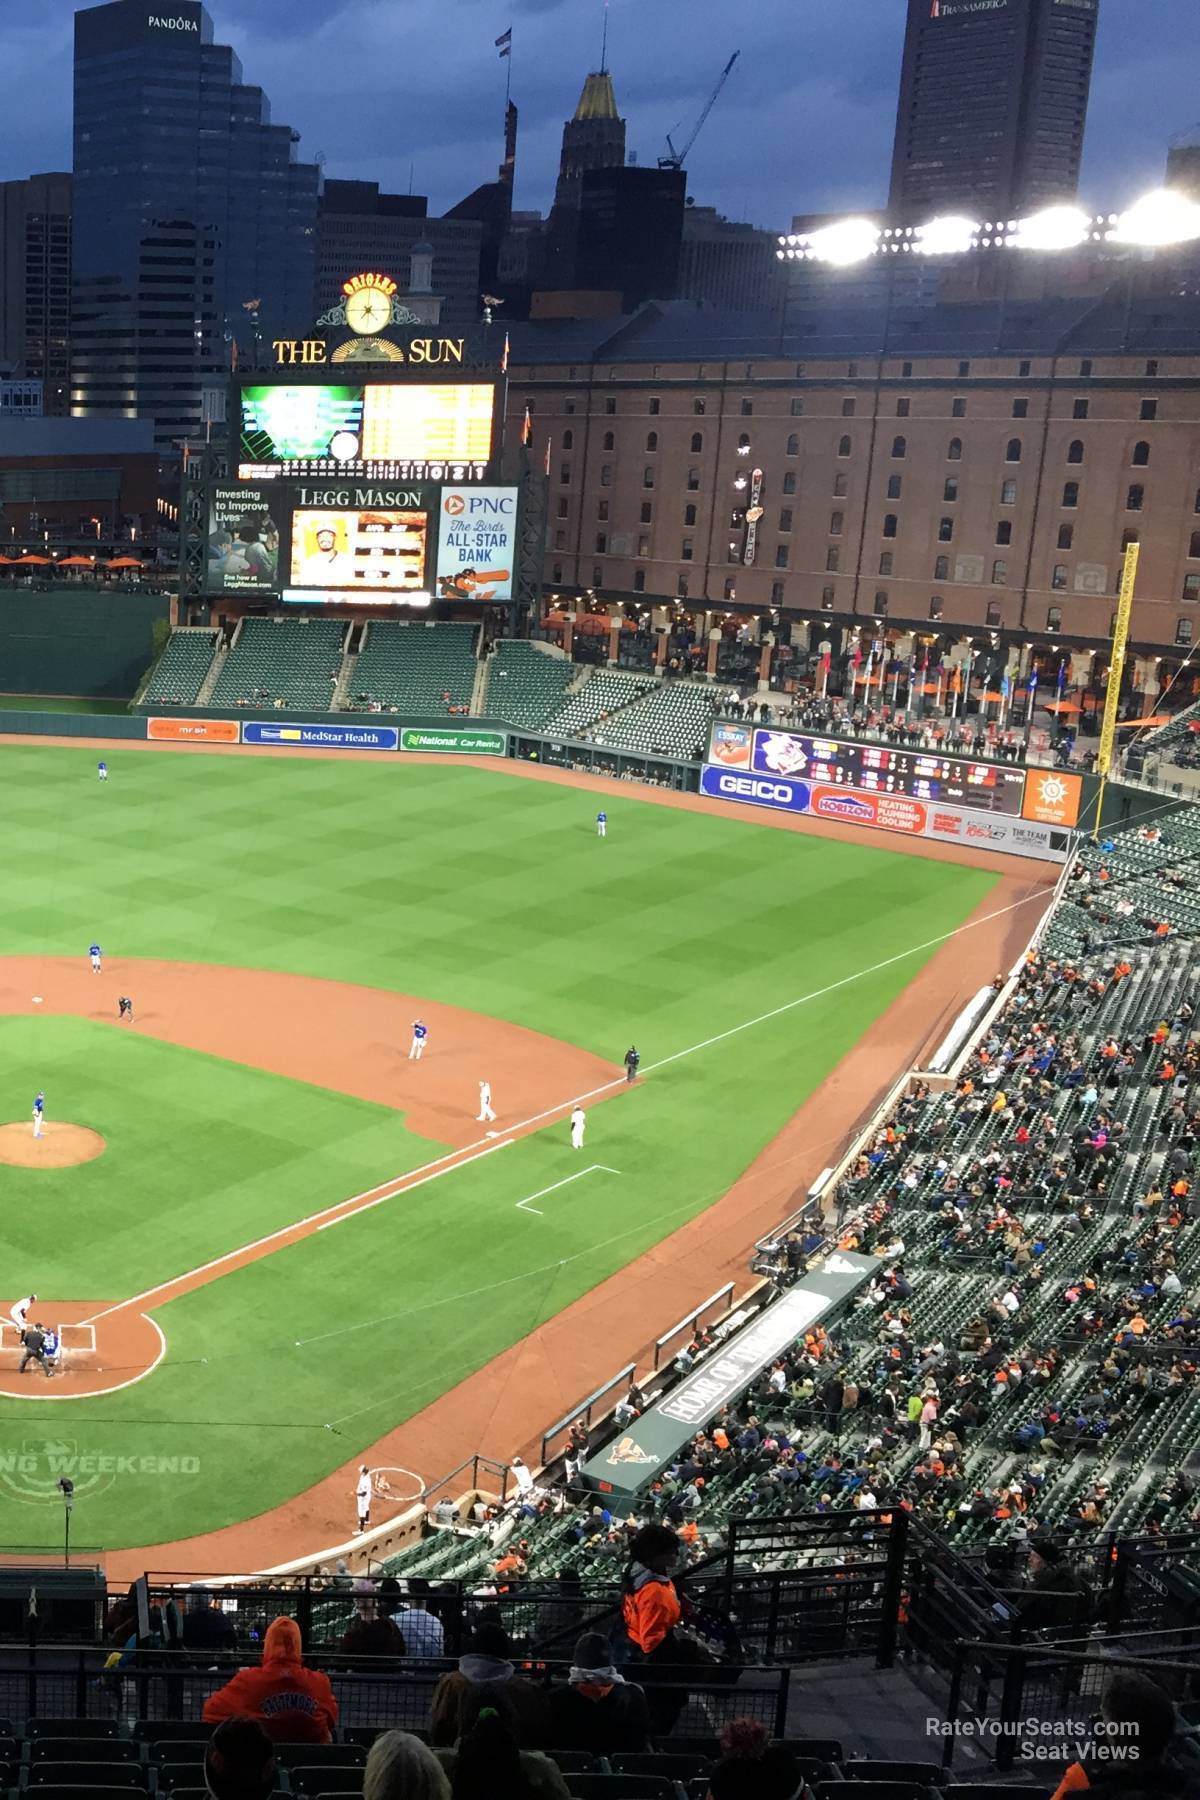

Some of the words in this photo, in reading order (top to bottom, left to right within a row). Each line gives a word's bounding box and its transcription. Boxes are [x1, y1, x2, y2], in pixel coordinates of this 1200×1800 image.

[343, 273, 398, 295] ORIOLES
[272, 340, 327, 364] THE
[408, 338, 465, 363] SUN
[215, 489, 261, 500] Investing
[300, 488, 350, 506] LEGG
[354, 489, 422, 507] MASON
[215, 501, 226, 510] to
[228, 501, 269, 512] Improve
[469, 497, 513, 514] PNC
[450, 520, 471, 532] The
[472, 519, 504, 532] Birds
[446, 533, 507, 547] ALL-STAR
[458, 548, 492, 562] BANK
[302, 730, 343, 742] MedStar
[345, 732, 379, 744] Health
[419, 735, 456, 746] National
[460, 739, 476, 747] Car
[476, 740, 501, 749] Rental
[719, 775, 793, 803] GEICO
[819, 799, 874, 819] HORIZON
[877, 799, 916, 813] HEATING
[877, 807, 921, 823] PLUMBING
[876, 816, 914, 829] COOLING
[1026, 829, 1048, 840] TEAM
[664, 1376, 728, 1420] HOME
[709, 1359, 746, 1381] OF
[48, 1455, 200, 1474] WEEKEND
